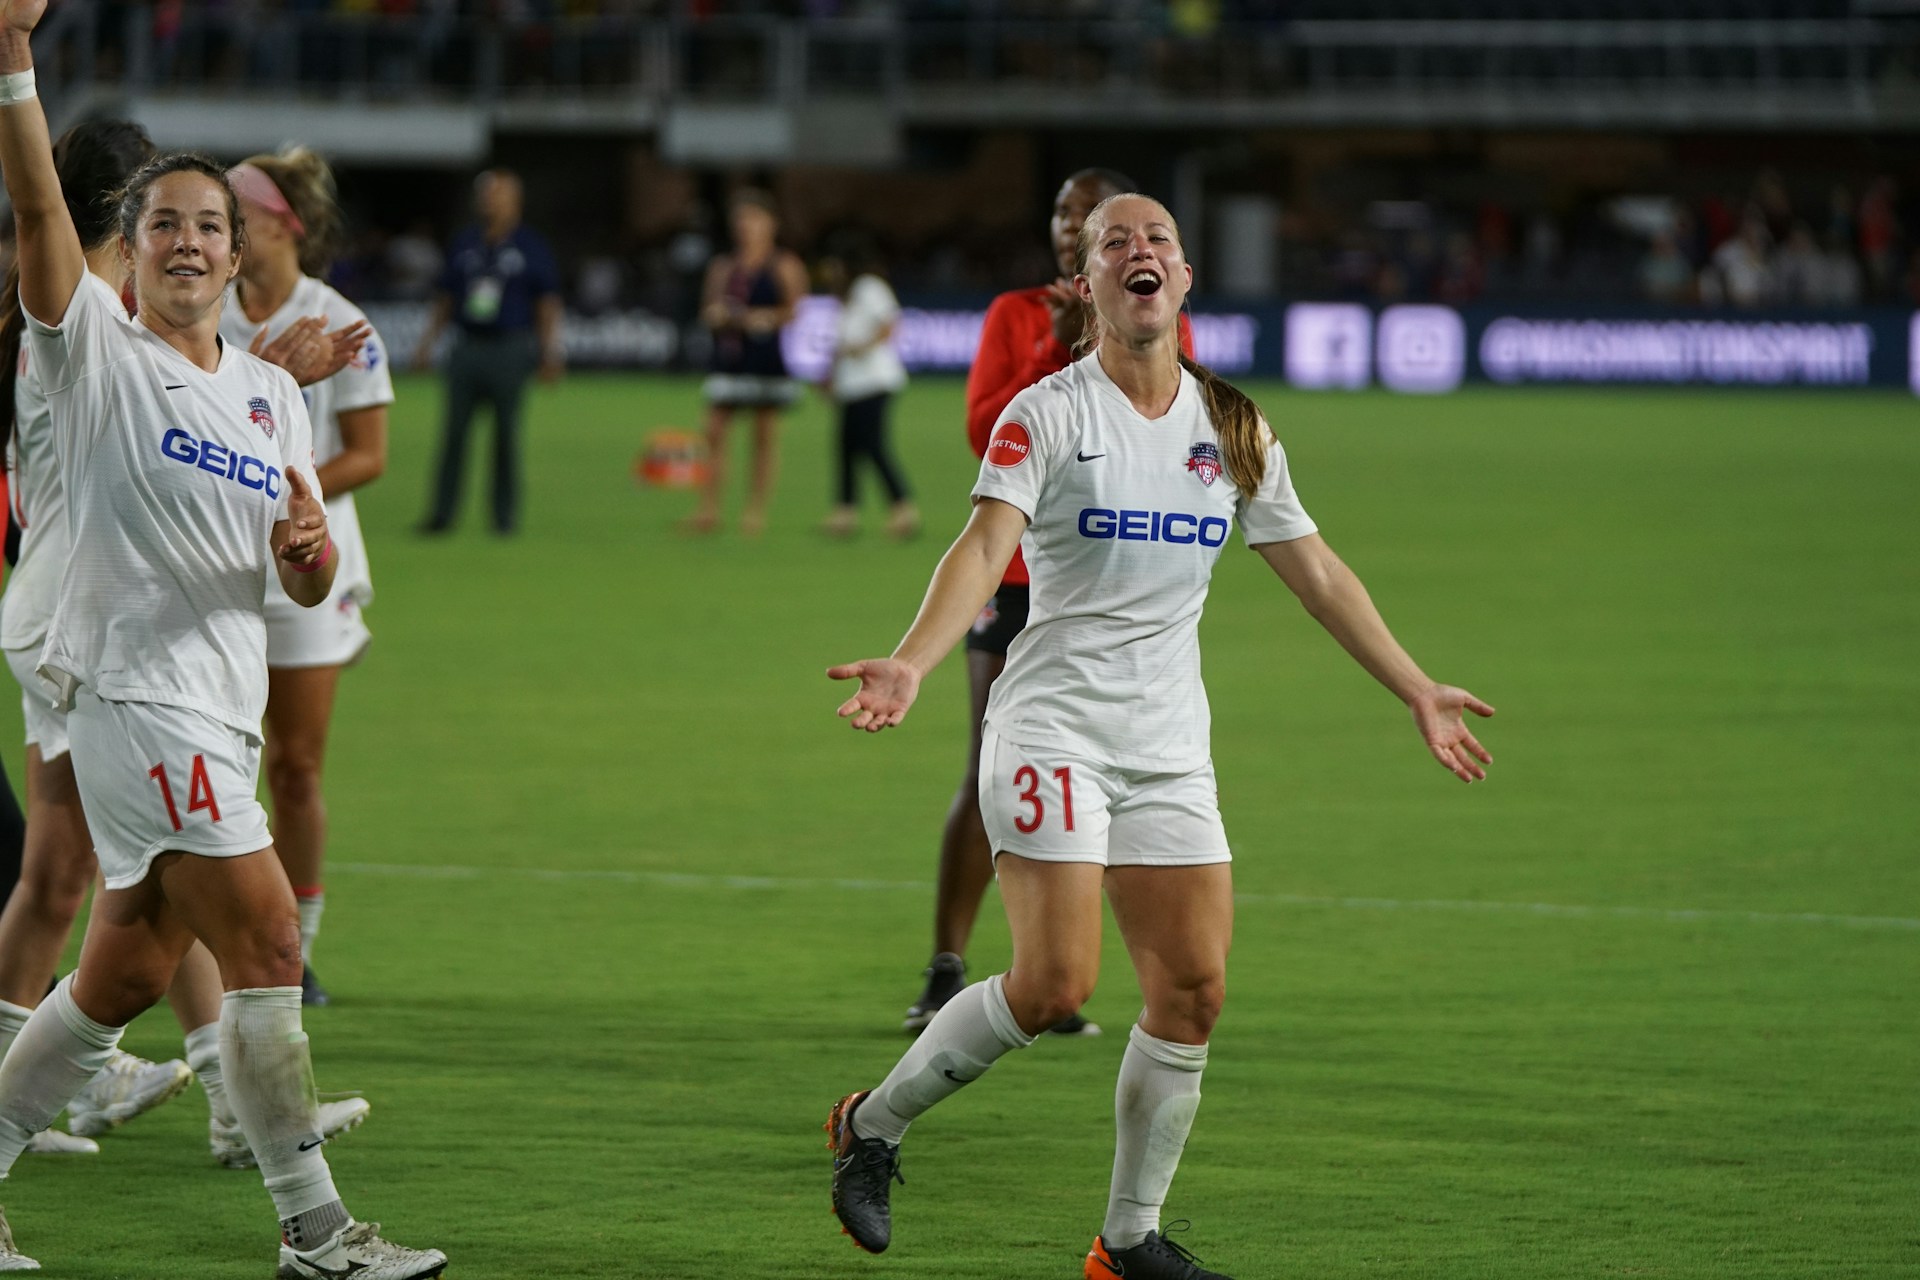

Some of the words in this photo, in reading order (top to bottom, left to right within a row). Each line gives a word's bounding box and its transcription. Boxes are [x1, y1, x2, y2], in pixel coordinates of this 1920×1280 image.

[161, 428, 280, 500] GEICO
[1194, 457, 1218, 468] SPIRIT
[1078, 508, 1228, 547] GEICO
[147, 752, 223, 833] 14
[1013, 764, 1075, 835] 31
